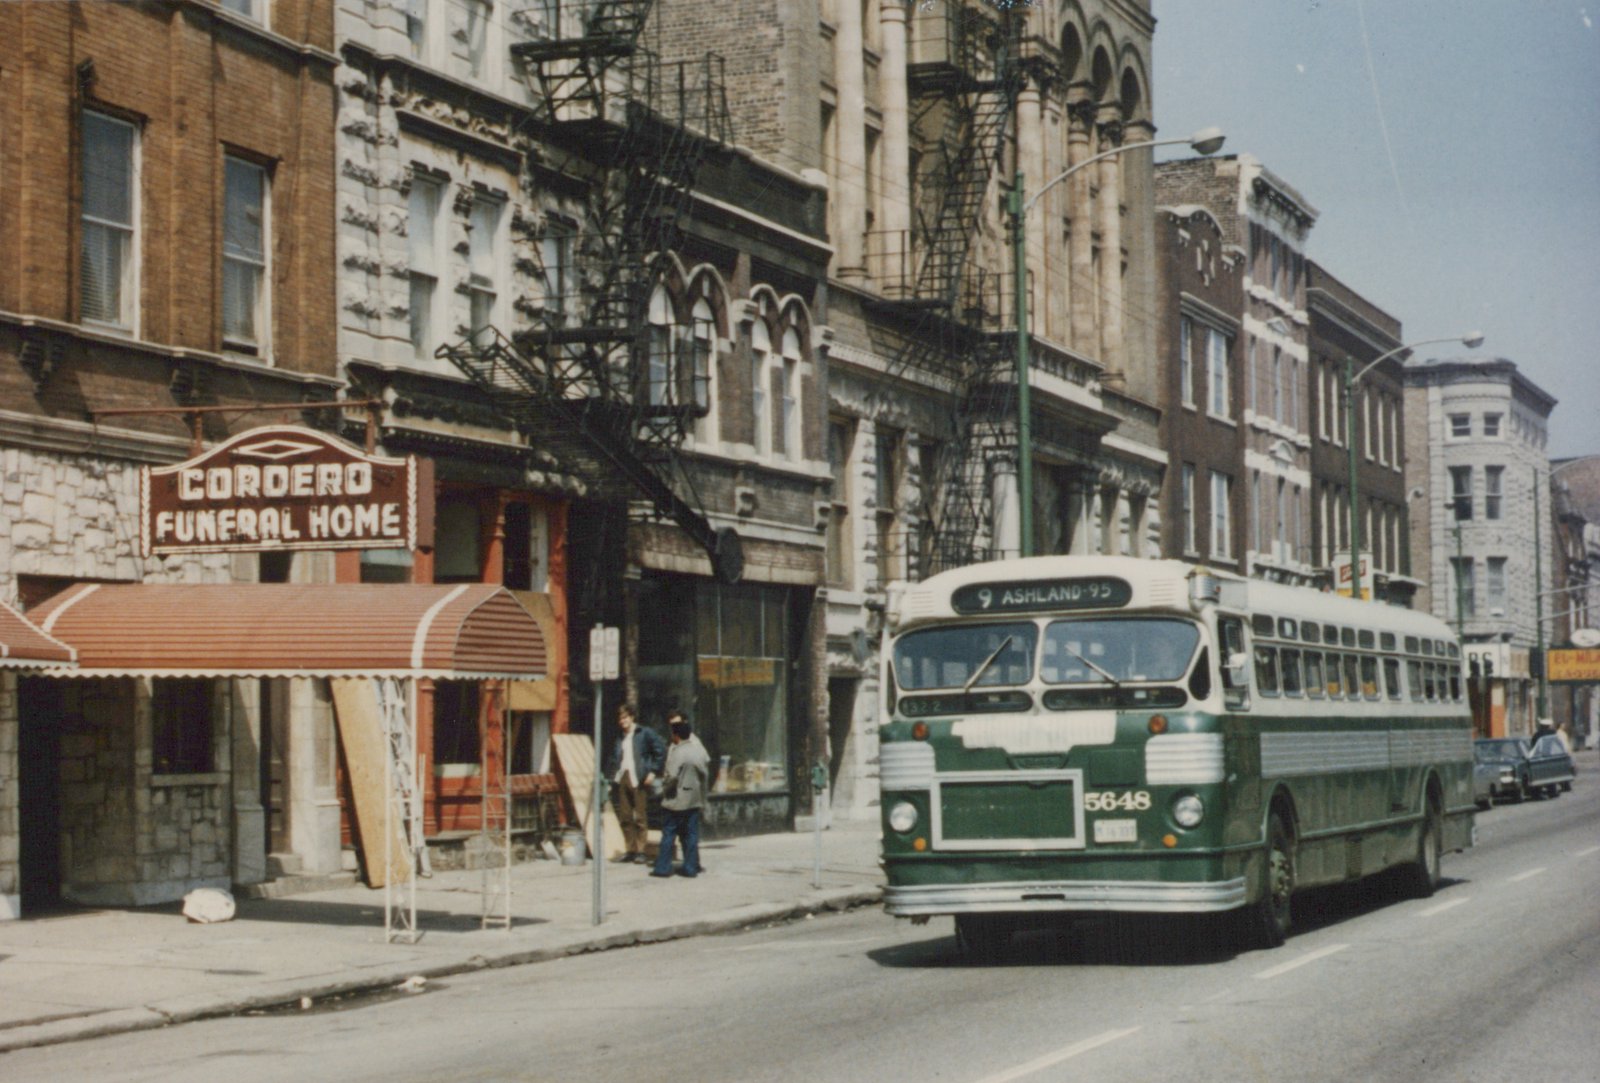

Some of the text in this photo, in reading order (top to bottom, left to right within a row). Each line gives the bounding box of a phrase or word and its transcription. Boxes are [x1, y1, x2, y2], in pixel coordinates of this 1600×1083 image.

[178, 463, 372, 500] CORDERO
[155, 503, 401, 542] FUNERAL HOME
[979, 588, 993, 609] 9
[1084, 790, 1152, 811] 5648
